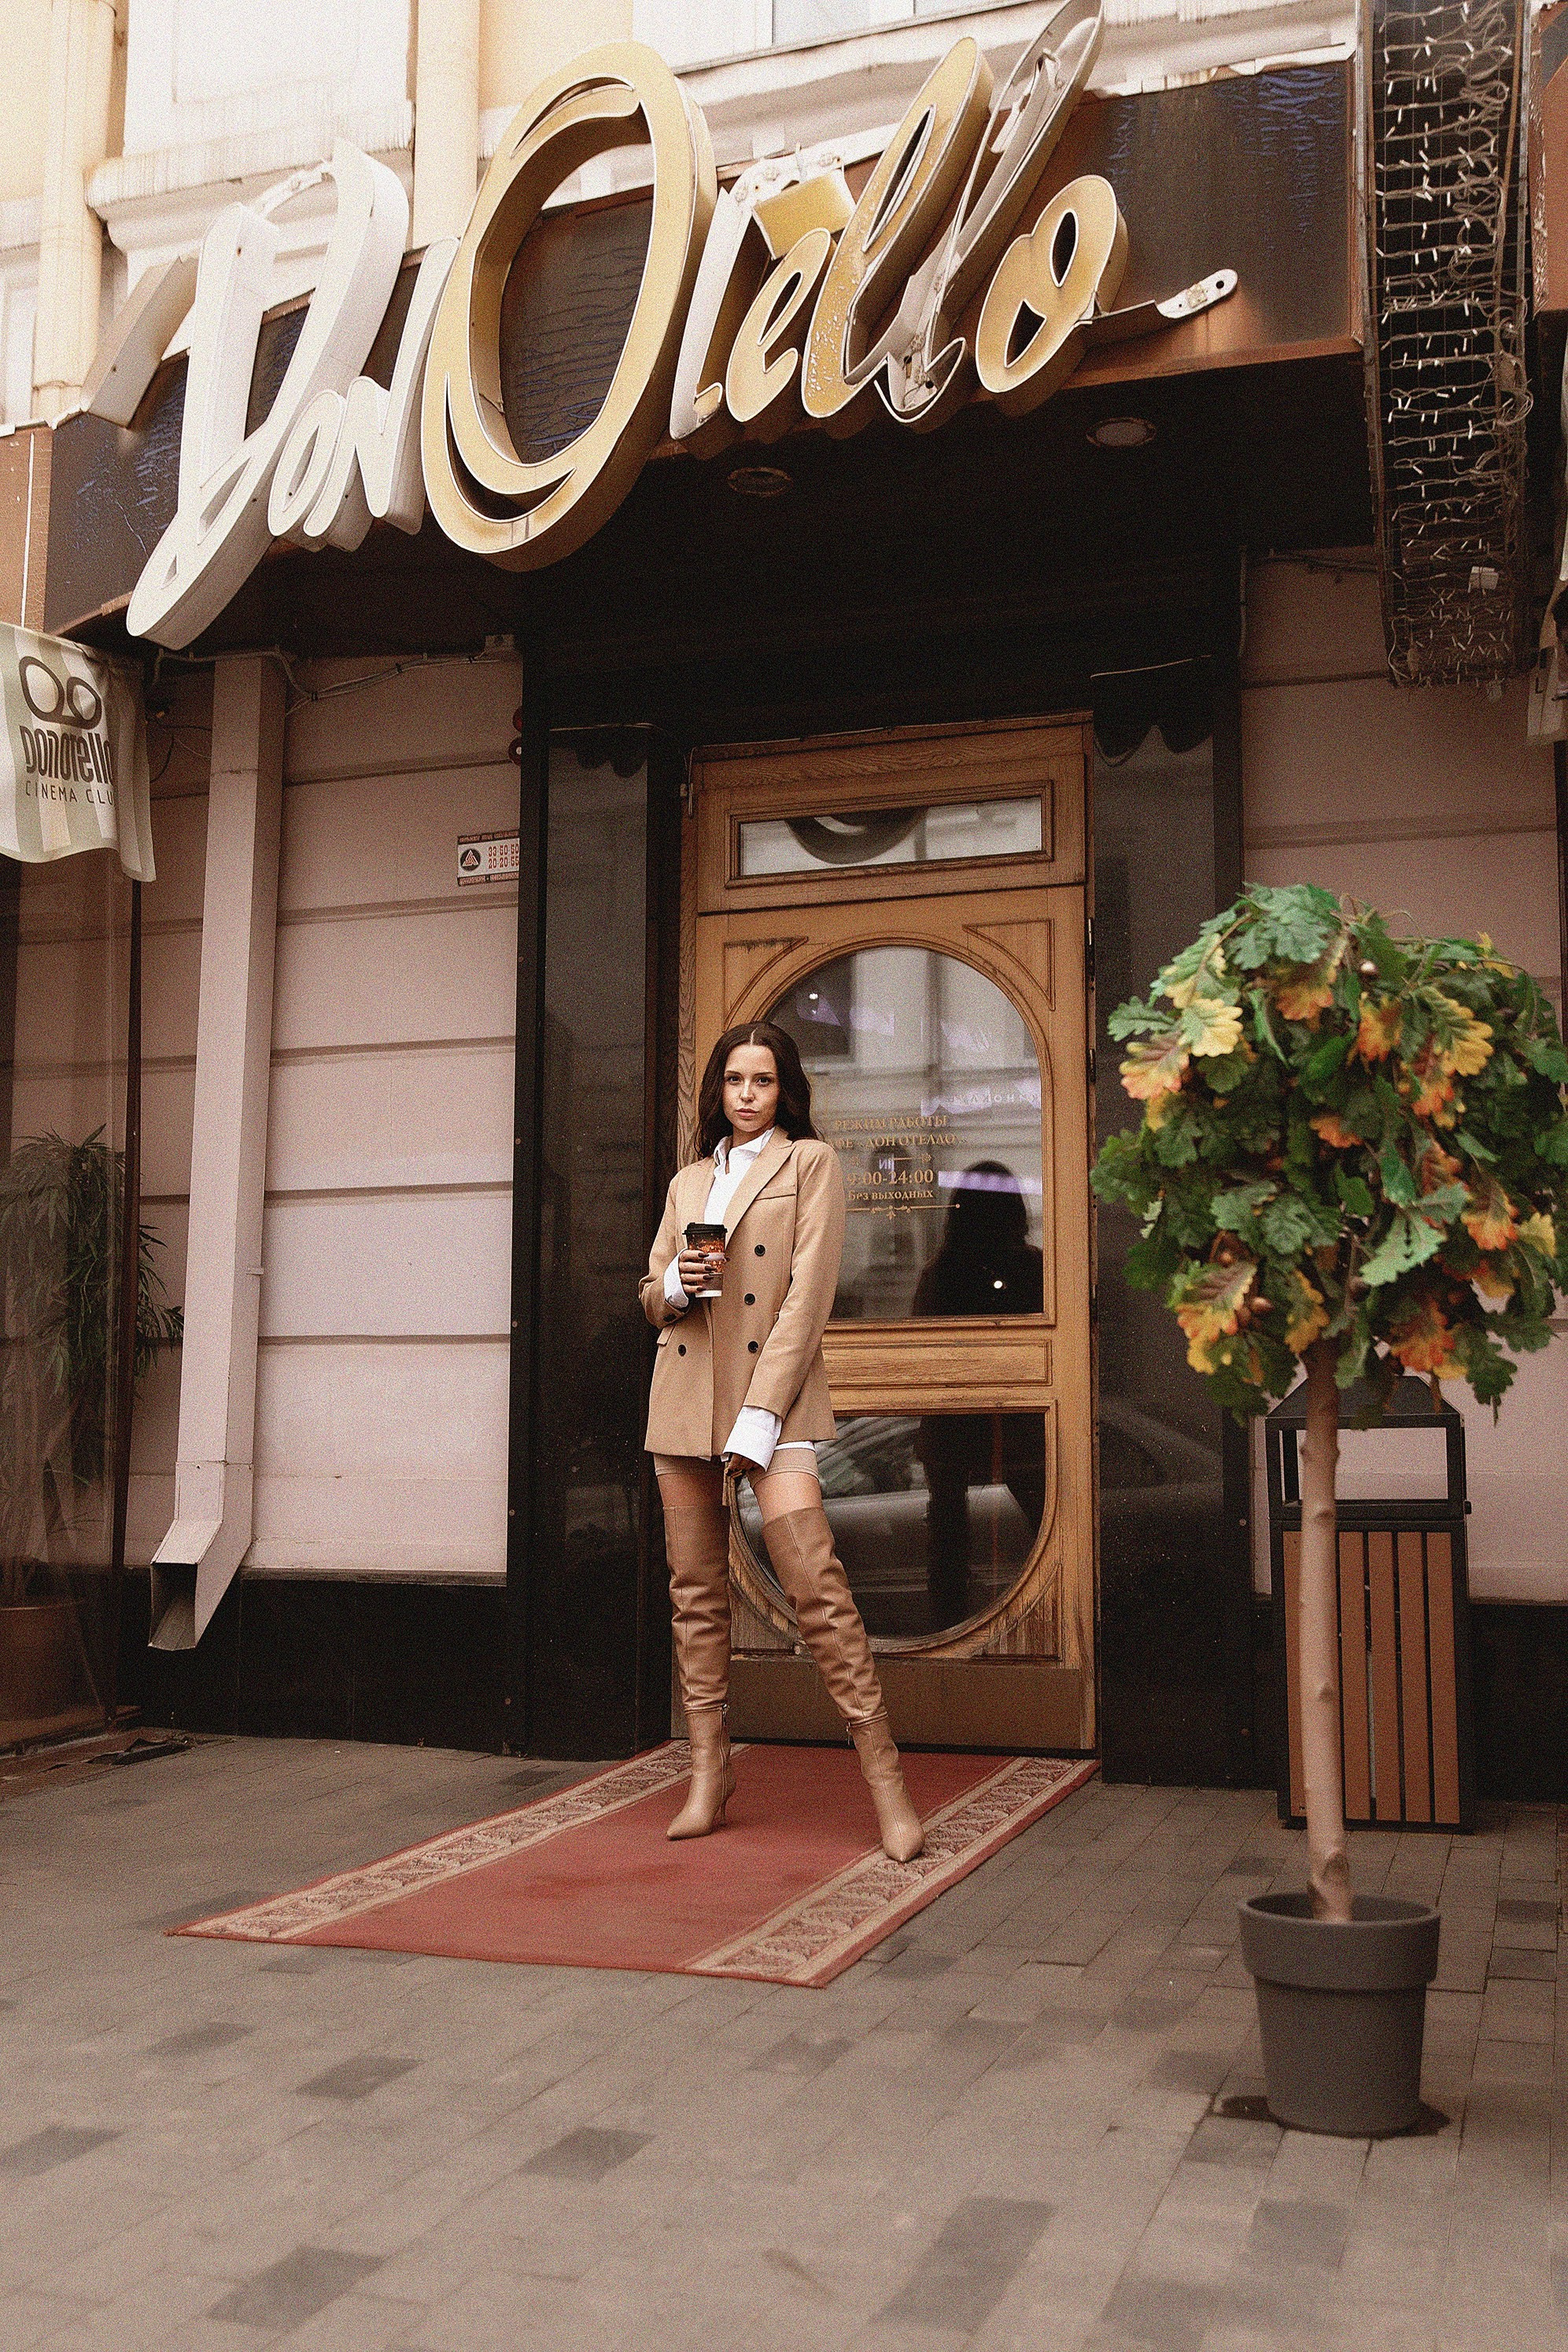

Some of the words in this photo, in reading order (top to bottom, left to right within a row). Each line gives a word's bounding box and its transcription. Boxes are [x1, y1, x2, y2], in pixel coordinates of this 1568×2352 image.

[25, 781, 78, 803] CINEMA
[85, 788, 115, 806] CLU
[834, 1117, 887, 1131] РЕЖИМ
[889, 1115, 947, 1128] РАБОТЫ
[847, 1169, 934, 1186] 9:00-24:00
[848, 1190, 869, 1201] Без
[871, 1189, 934, 1201] выходных
